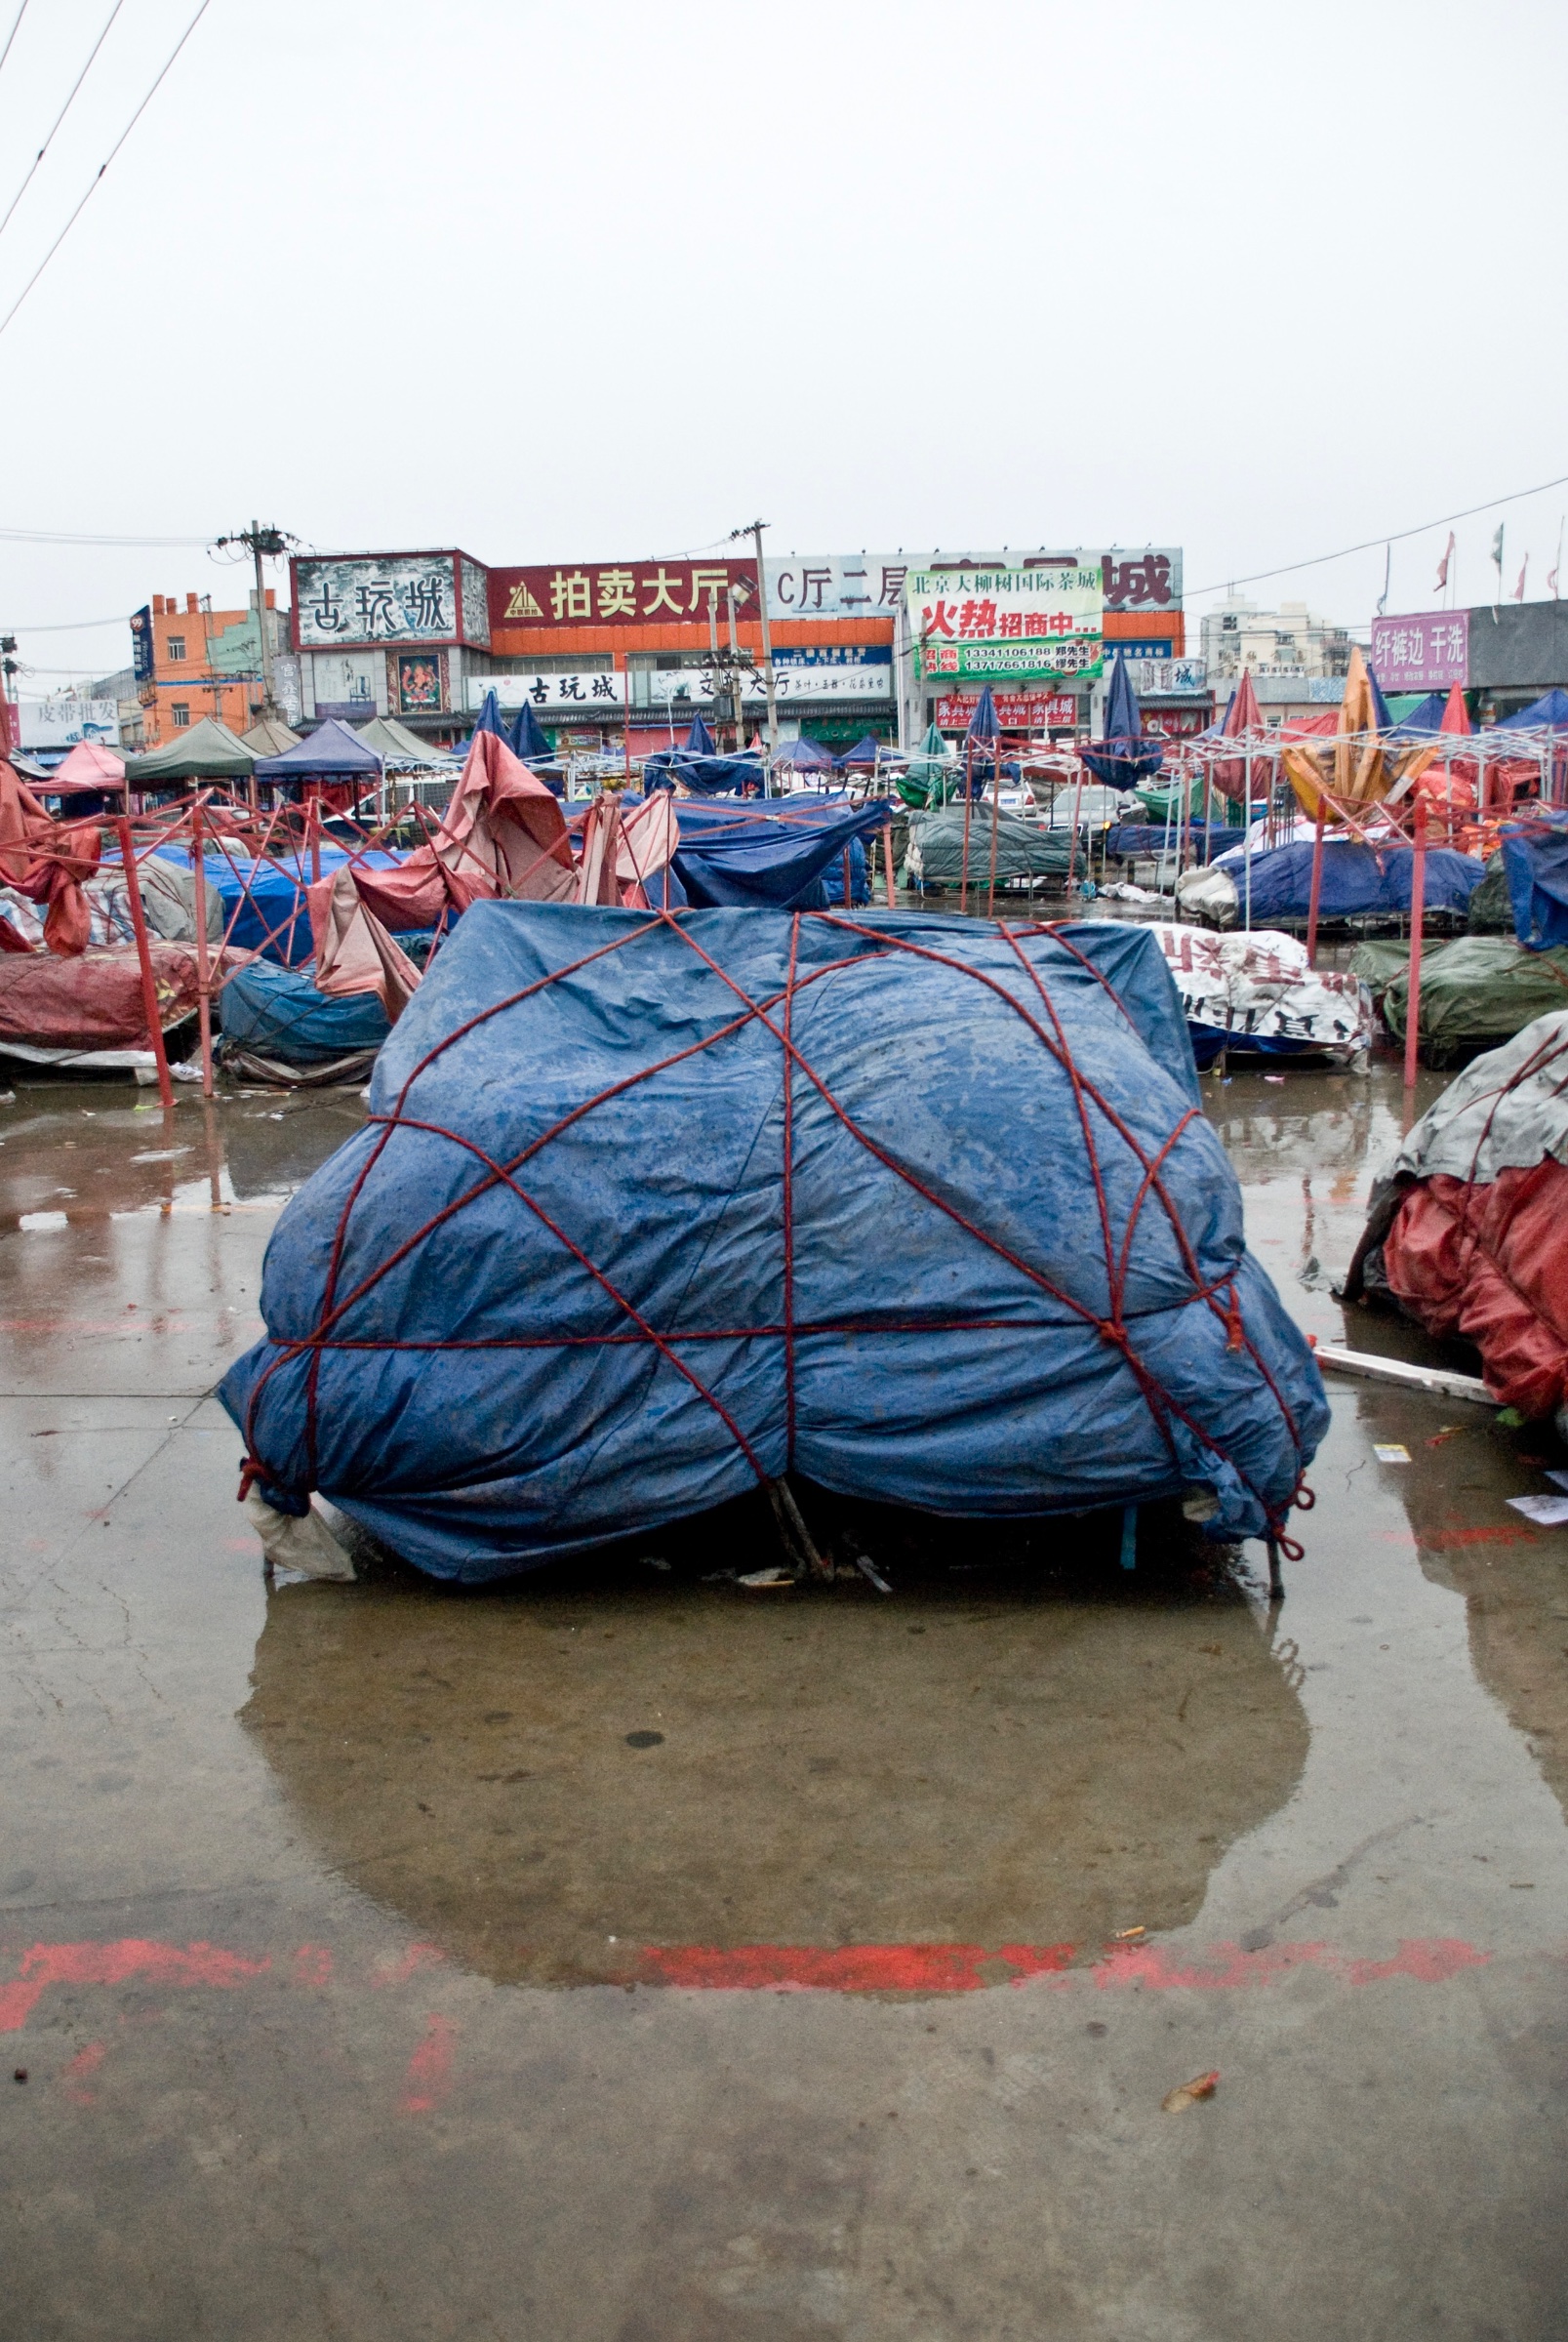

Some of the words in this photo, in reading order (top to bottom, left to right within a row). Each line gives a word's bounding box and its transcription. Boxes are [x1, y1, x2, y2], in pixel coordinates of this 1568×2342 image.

[549, 568, 730, 621] 拍卖大厅
[911, 571, 1097, 595] 北京大柳树国际茶城
[308, 577, 446, 630] 古玩城
[131, 618, 143, 627] 99
[965, 647, 1051, 659] 13341106188
[1055, 645, 1091, 658] 郑先生
[1429, 624, 1464, 665] 干洗
[965, 660, 1051, 670] 13717661816
[529, 674, 618, 705] 古玩城
[38, 701, 116, 723] 皮带批发
[1031, 698, 1073, 714] 家具城
